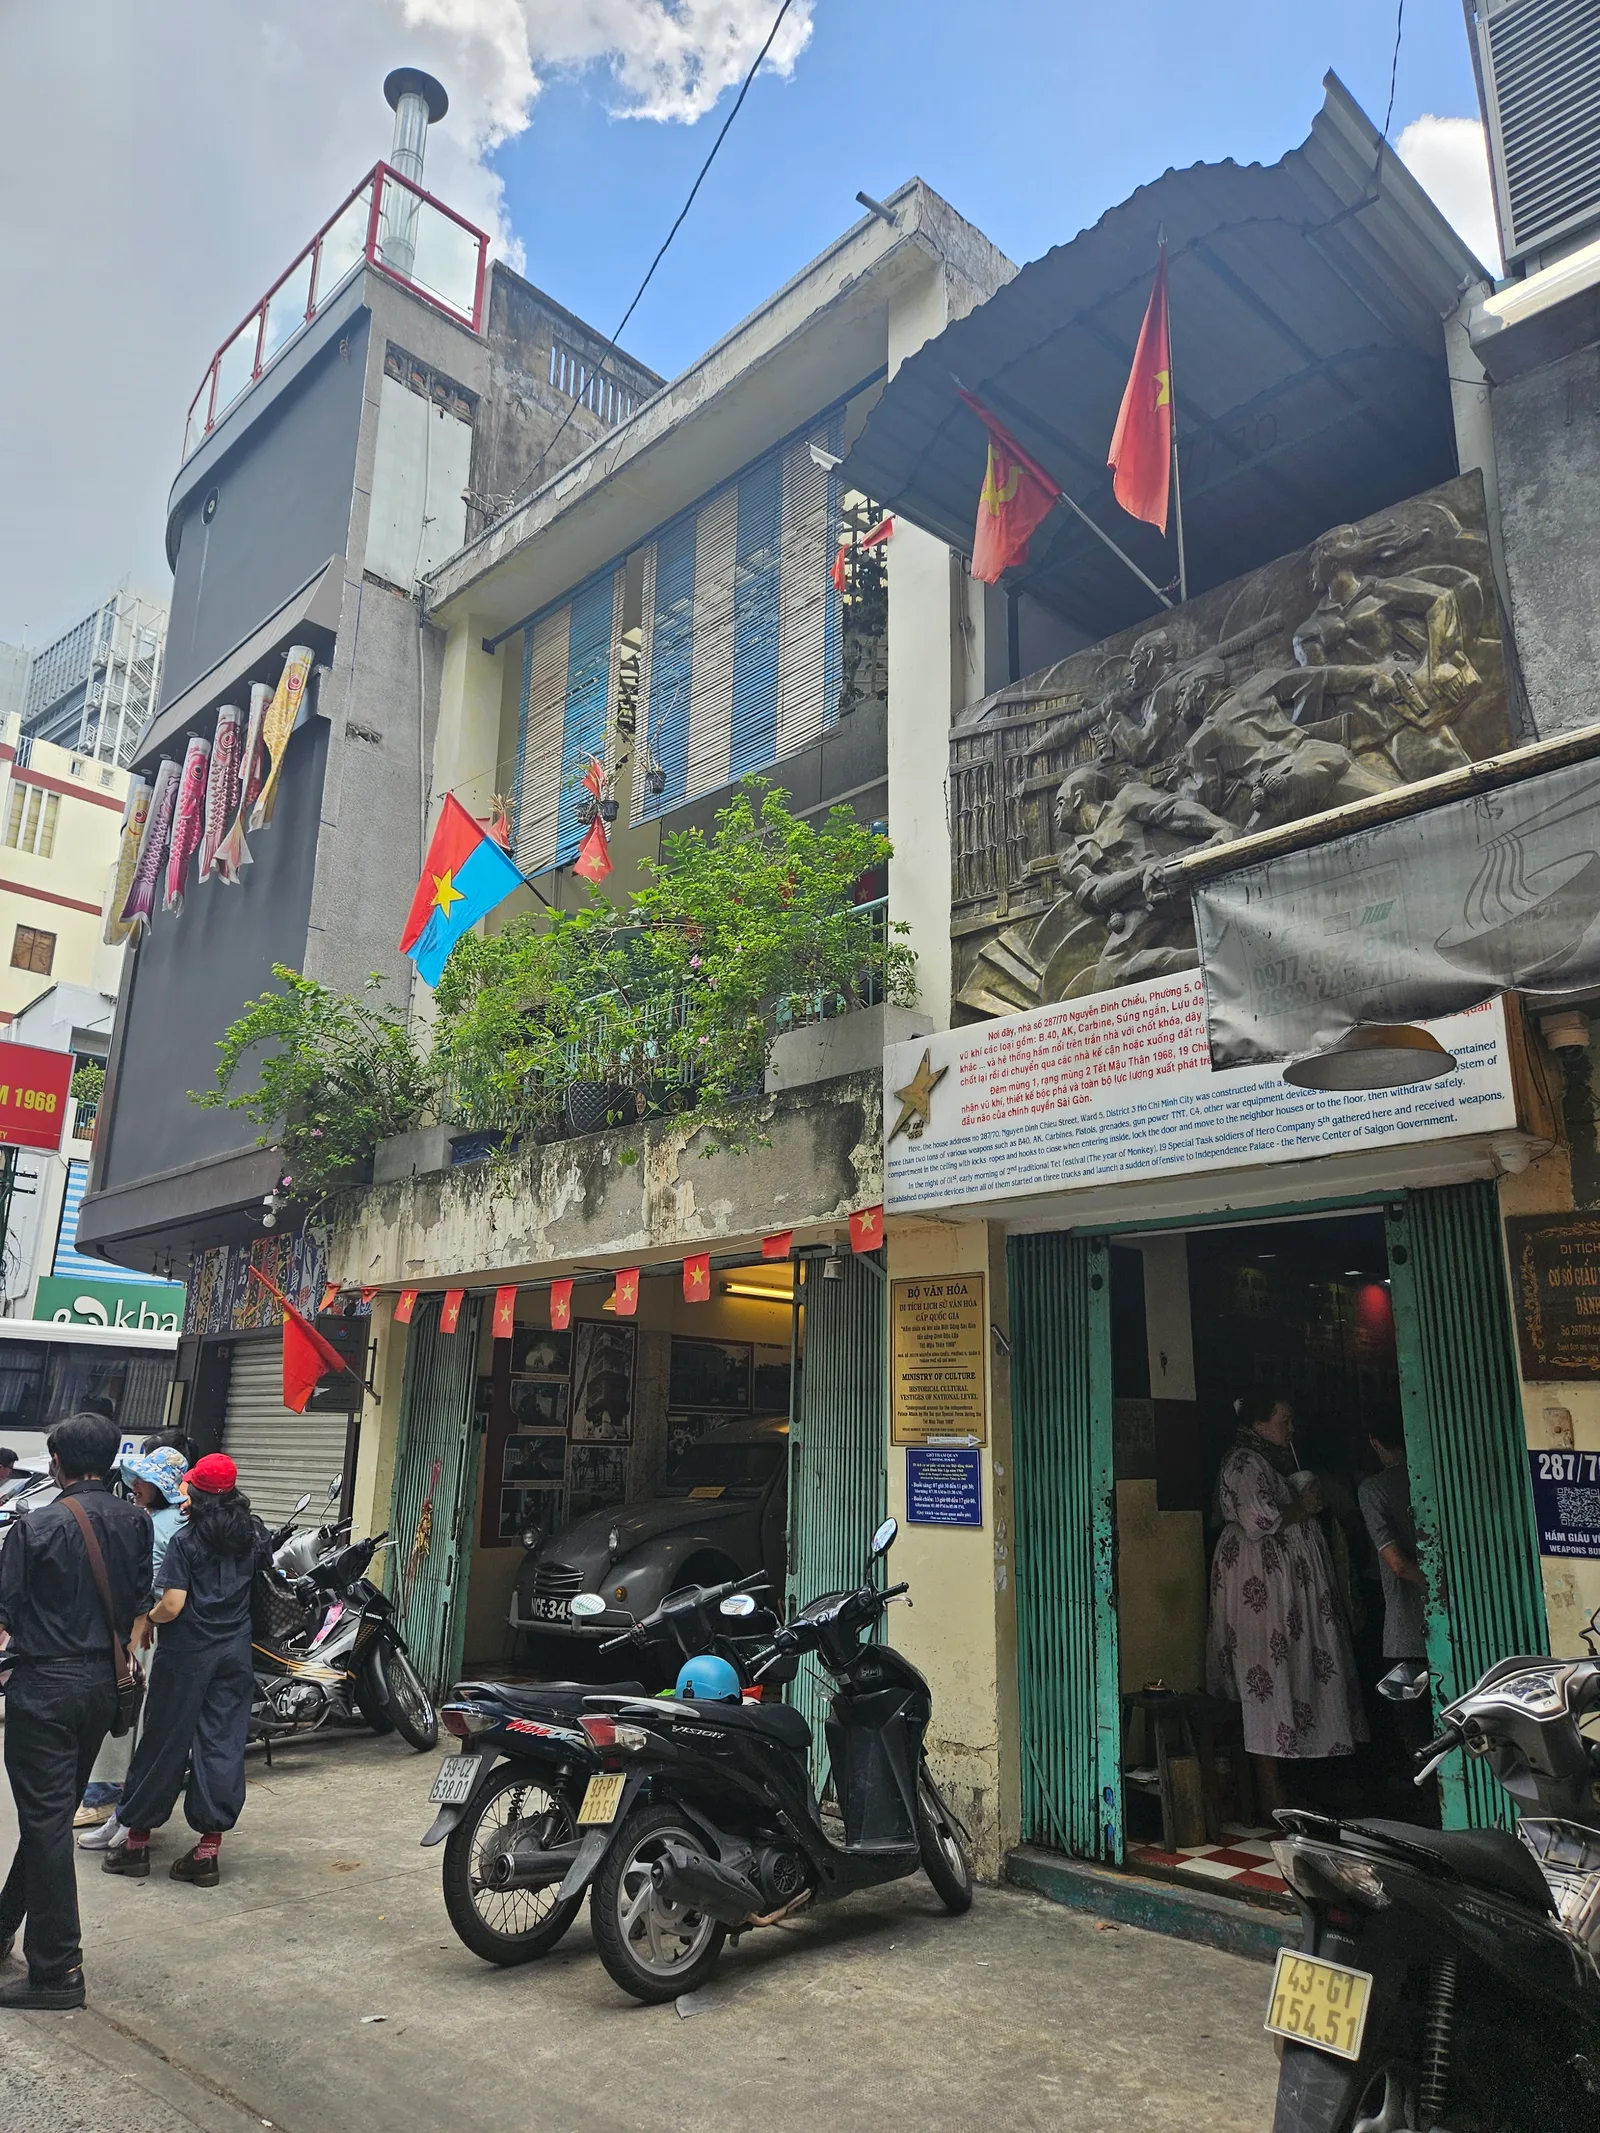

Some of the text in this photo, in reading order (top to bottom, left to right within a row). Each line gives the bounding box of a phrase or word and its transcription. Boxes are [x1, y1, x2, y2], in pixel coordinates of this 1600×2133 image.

[1017, 1022, 1031, 1033] nhà
[1033, 1017, 1042, 1029] số
[1100, 1001, 1119, 1013] Đình
[1149, 987, 1181, 1001] Phường
[983, 1044, 997, 1054] các
[999, 1039, 1014, 1051] loại
[1061, 1025, 1076, 1036] AK,
[1077, 1018, 1114, 1032] Carbine,
[1116, 1011, 1140, 1023] Súng
[1447, 1040, 1496, 1057] contained
[989, 1085, 1006, 1095] Đêm
[1008, 1080, 1030, 1091] mùng
[1032, 1077, 1039, 1087] 1,
[1040, 1074, 1058, 1085] rạng
[1060, 1069, 1083, 1080] mùng
[1085, 1066, 1090, 1075] 2
[1092, 1061, 1106, 1073] Tết
[1108, 1059, 1126, 1071] Mậu
[1128, 1054, 1150, 1066] Thân
[1152, 1048, 1175, 1061] 1968,
[1177, 1045, 1188, 1056] 19
[1453, 1059, 1484, 1073] ystem
[1211, 1082, 1256, 1098] constructed
[1257, 1079, 1275, 1090] with
[15, 1088, 56, 1113] 1968
[1193, 1077, 1465, 1128] move to the neighbor houses or to the floor, then withdraw safely.
[1203, 1086, 1316, 1113] other war equipment devices
[1167, 1091, 1504, 1151] Special Task soldiers of Hero Company 5th gathered here and received weapons,
[1194, 1145, 1247, 1159] Independence
[1248, 1141, 1274, 1151] Palace
[1280, 1137, 1294, 1146] the
[1295, 1134, 1320, 1144] Nerve
[1321, 1130, 1351, 1140] Center
[1352, 1125, 1361, 1136] of
[1364, 1123, 1394, 1135] Saigon
[1396, 1113, 1457, 1129] Government.
[908, 1282, 968, 1300] BỘ VĂN HÓA
[908, 1302, 922, 1311] TÍCH
[924, 1302, 938, 1311] LỊCH
[949, 1300, 962, 1308] VĂN
[964, 1298, 977, 1307] HÓA
[916, 1310, 959, 1322] CẤP QUỐC GIA
[1538, 1453, 1600, 1483] 287/7
[1550, 1544, 1586, 1554] WEAPONS
[671, 1724, 726, 1738] VISION
[444, 1758, 475, 1777] 59-C2
[432, 1780, 469, 1800] 538.01
[590, 1777, 619, 1798] 93-P1
[579, 1800, 616, 1822] 713.59
[1326, 1933, 1356, 1946] HONDA
[1288, 1959, 1354, 2008] 43-G1
[1276, 1994, 1357, 2050] 154.51
